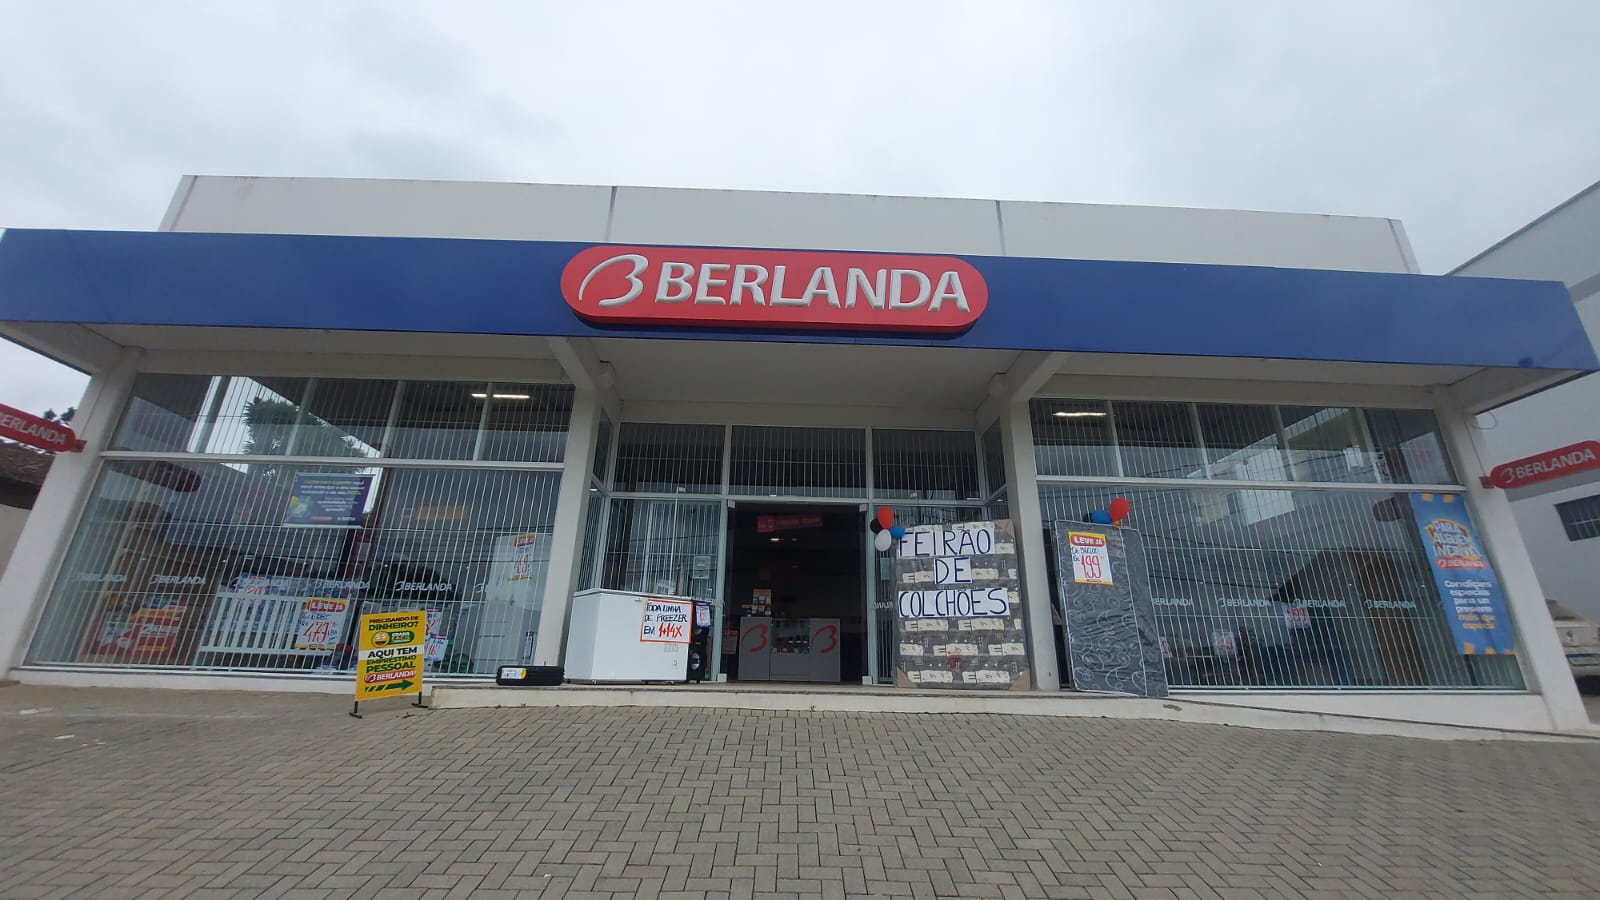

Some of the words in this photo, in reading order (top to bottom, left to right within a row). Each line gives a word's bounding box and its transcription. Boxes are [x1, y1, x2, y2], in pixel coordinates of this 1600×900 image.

[654, 261, 971, 313] BERLANDA
[1515, 447, 1596, 479] BERLANDA
[900, 528, 991, 557] FEIRÃO
[935, 557, 971, 584] DE
[404, 582, 452, 592] BERLANDA
[899, 588, 1007, 617] COLCHÕES
[1227, 599, 1271, 607] BERLANDA
[369, 616, 409, 624] PRECISANDO
[657, 613, 688, 622] FREEZER
[369, 621, 419, 631] DINHEIRO?
[644, 625, 655, 635] EM
[368, 648, 394, 659] AQUI
[396, 647, 418, 655] TEM
[366, 661, 416, 673] PESSOAL
[377, 670, 415, 680] BERLANDA
